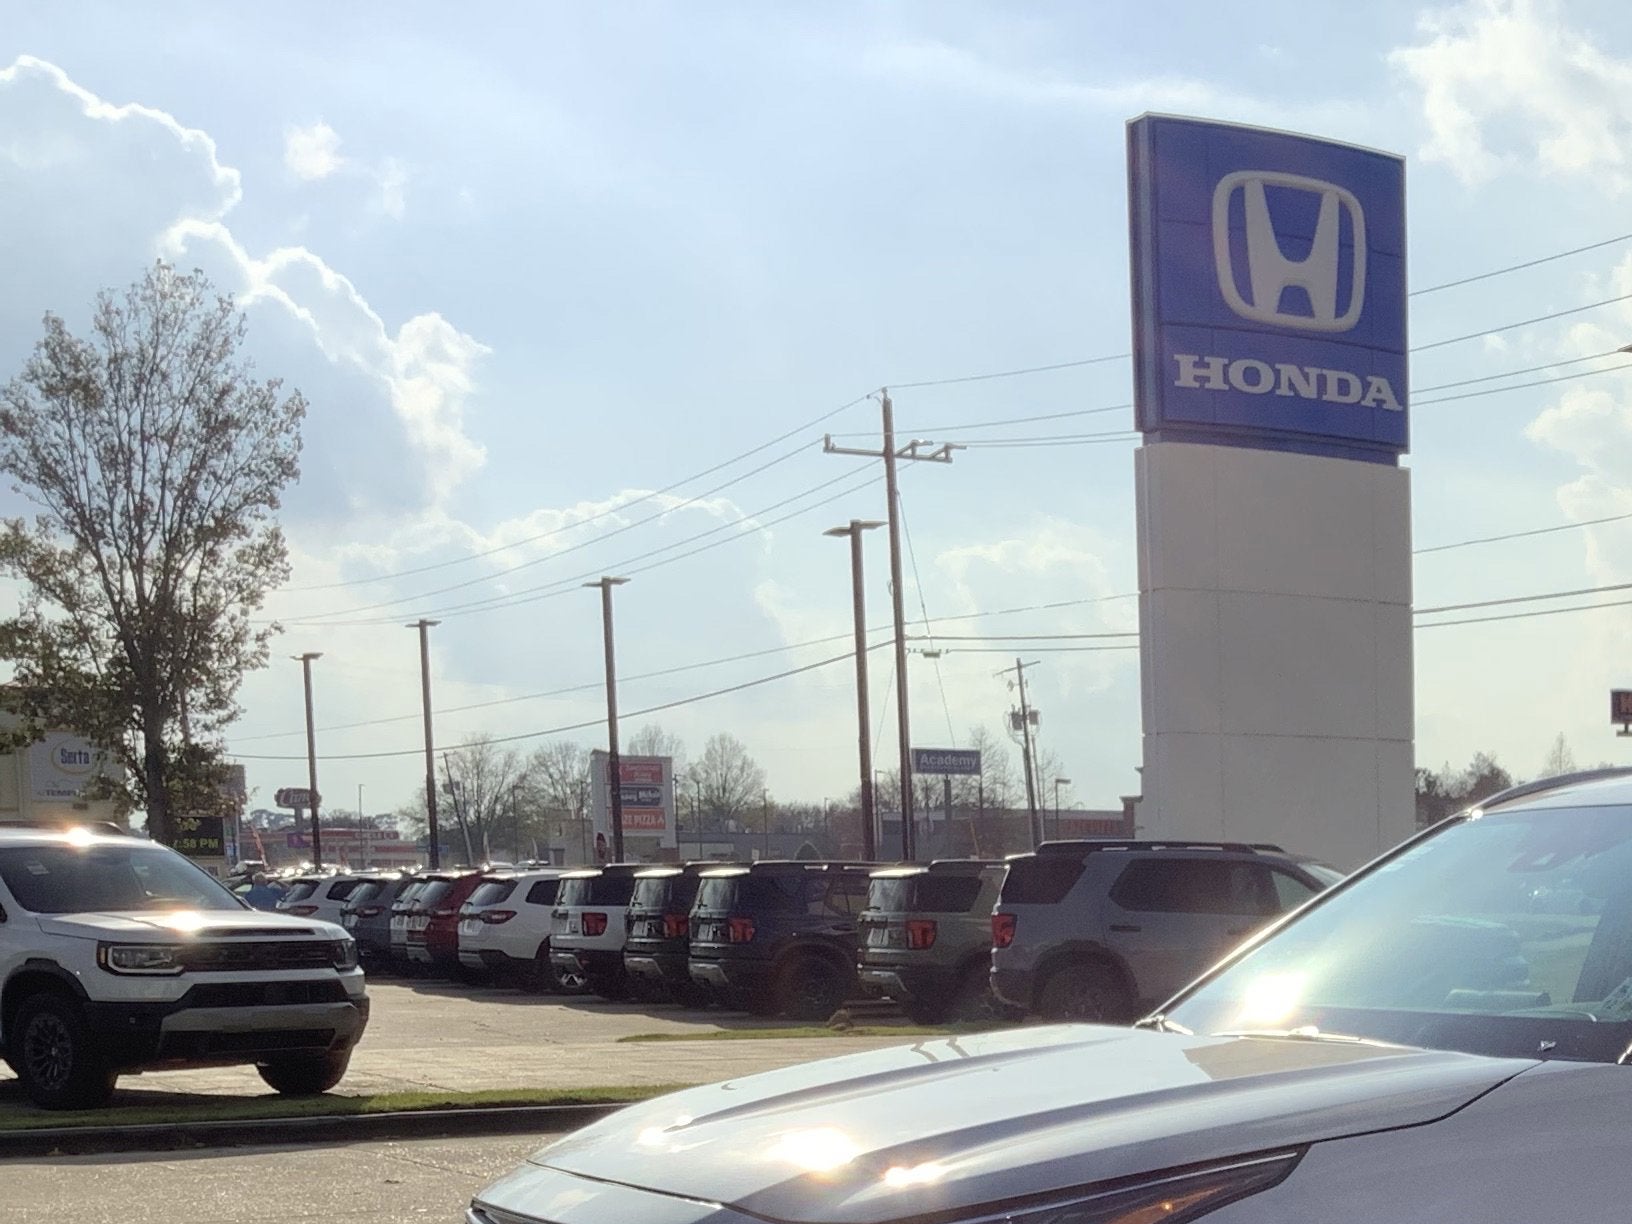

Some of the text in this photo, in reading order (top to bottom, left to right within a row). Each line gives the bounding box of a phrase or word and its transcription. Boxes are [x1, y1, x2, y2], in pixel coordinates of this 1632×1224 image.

[1173, 354, 1403, 411] HONDA
[60, 748, 90, 764] Serta
[920, 753, 977, 768] Academy
[199, 838, 219, 849] PM
